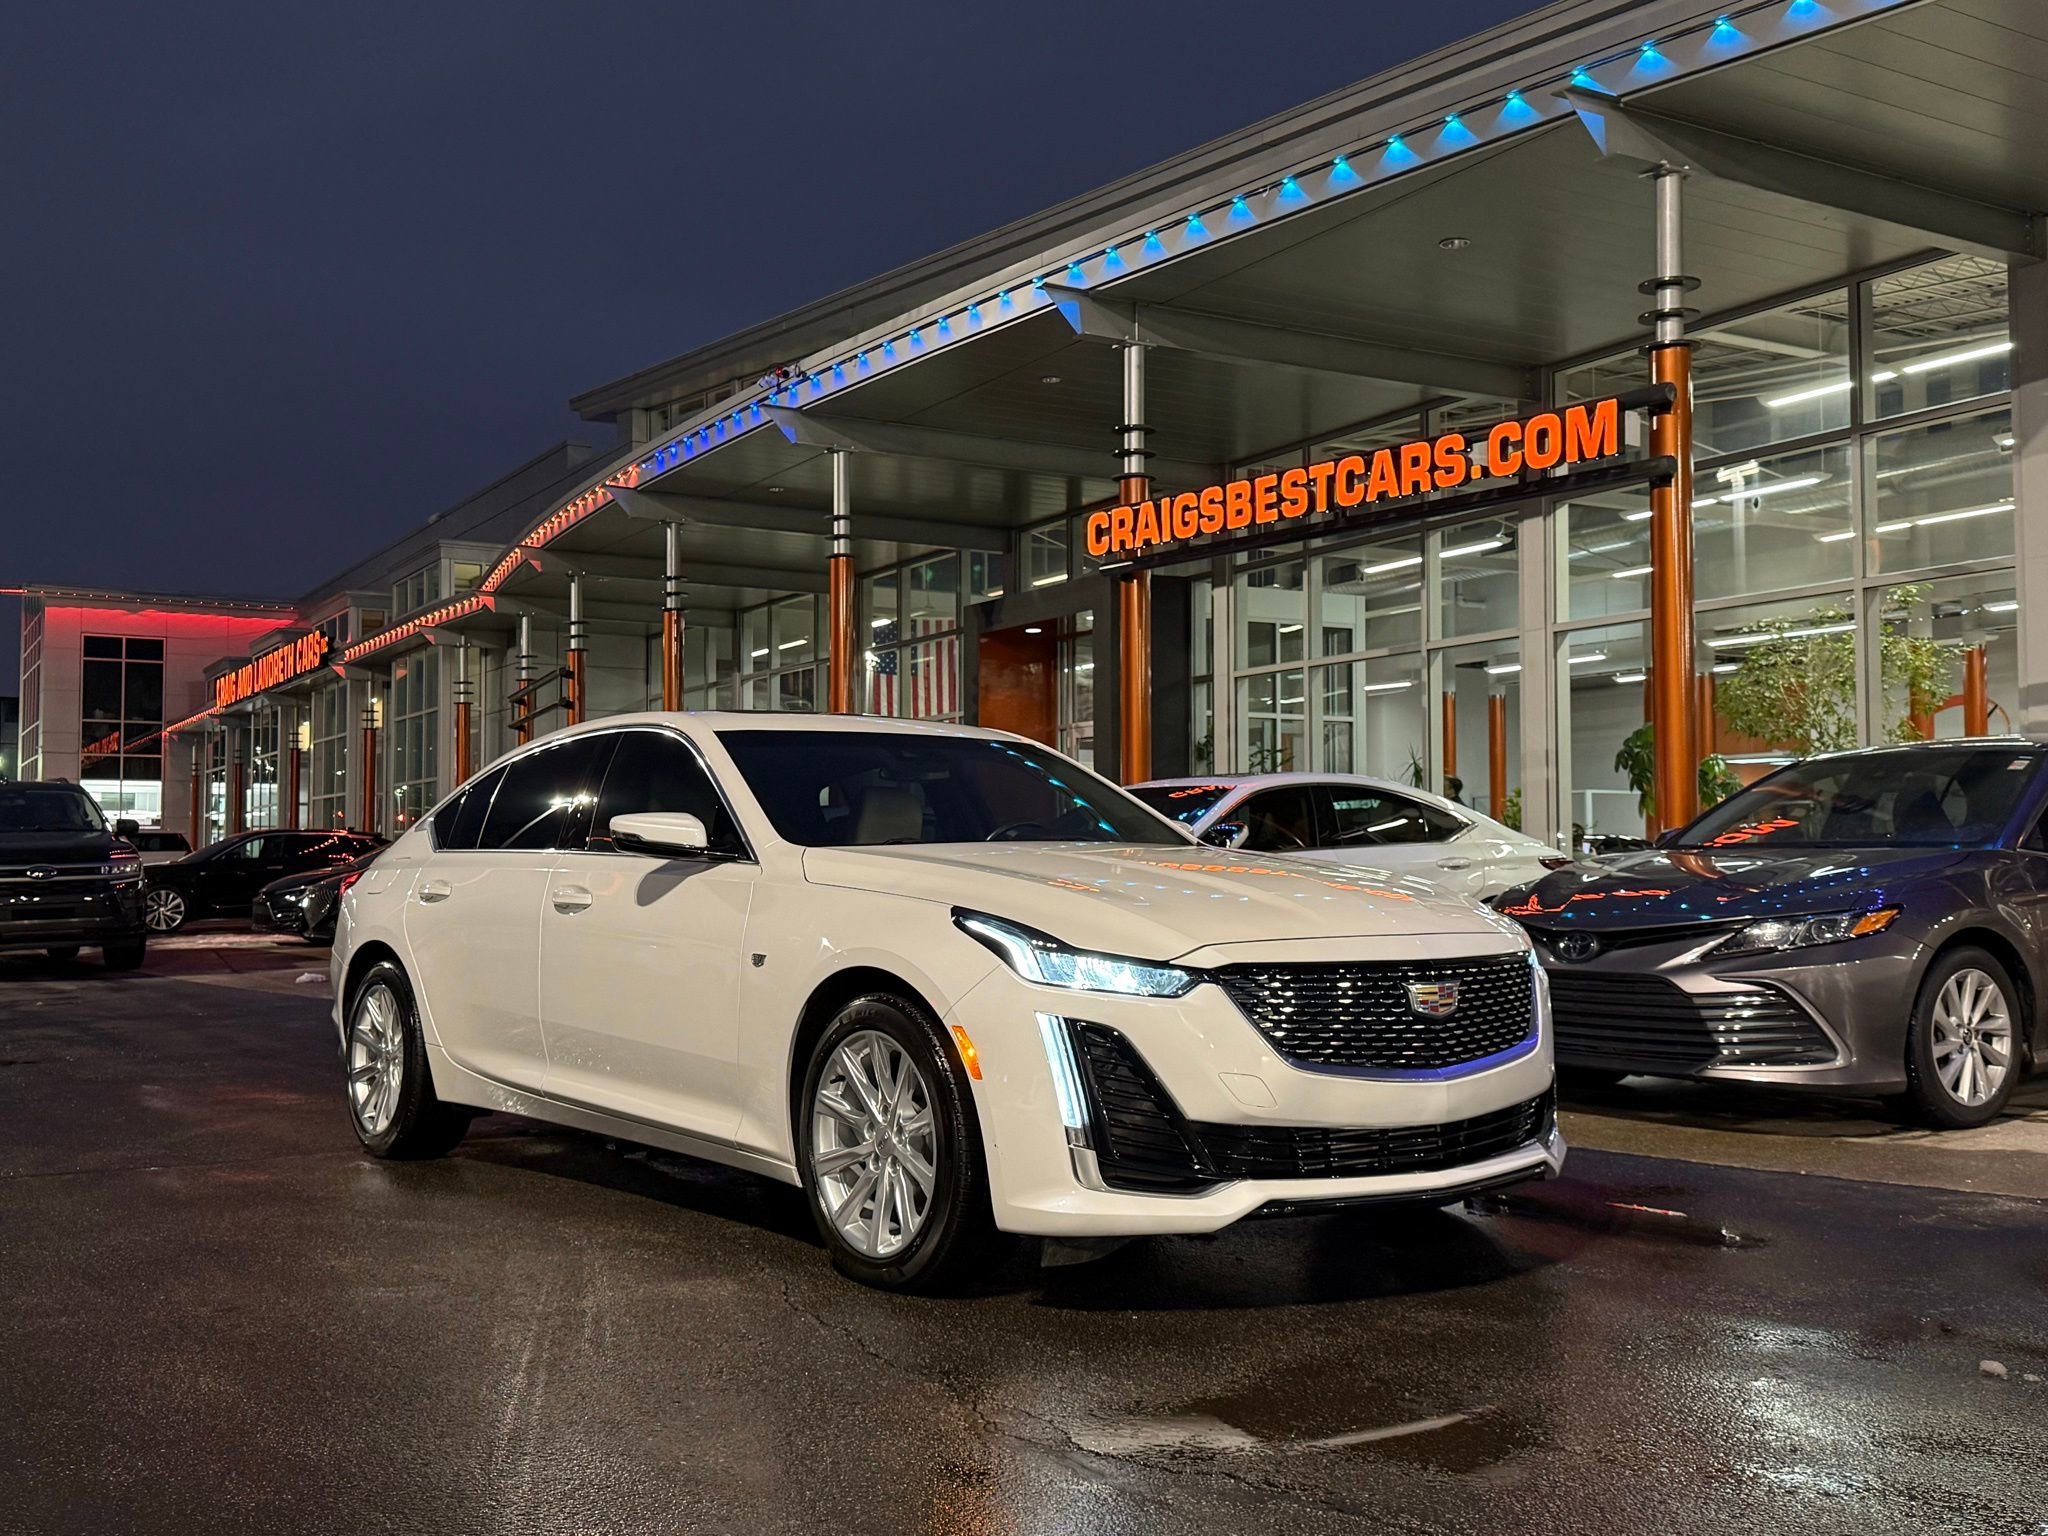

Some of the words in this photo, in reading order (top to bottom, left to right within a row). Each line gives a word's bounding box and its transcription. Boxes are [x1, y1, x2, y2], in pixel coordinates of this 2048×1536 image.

[1086, 398, 1619, 557] CRAIGSBESTCARS.COM
[216, 672, 236, 707] CRAIG
[237, 664, 253, 701] AND
[254, 643, 295, 693] LANDRETH
[296, 630, 320, 674] CARS
